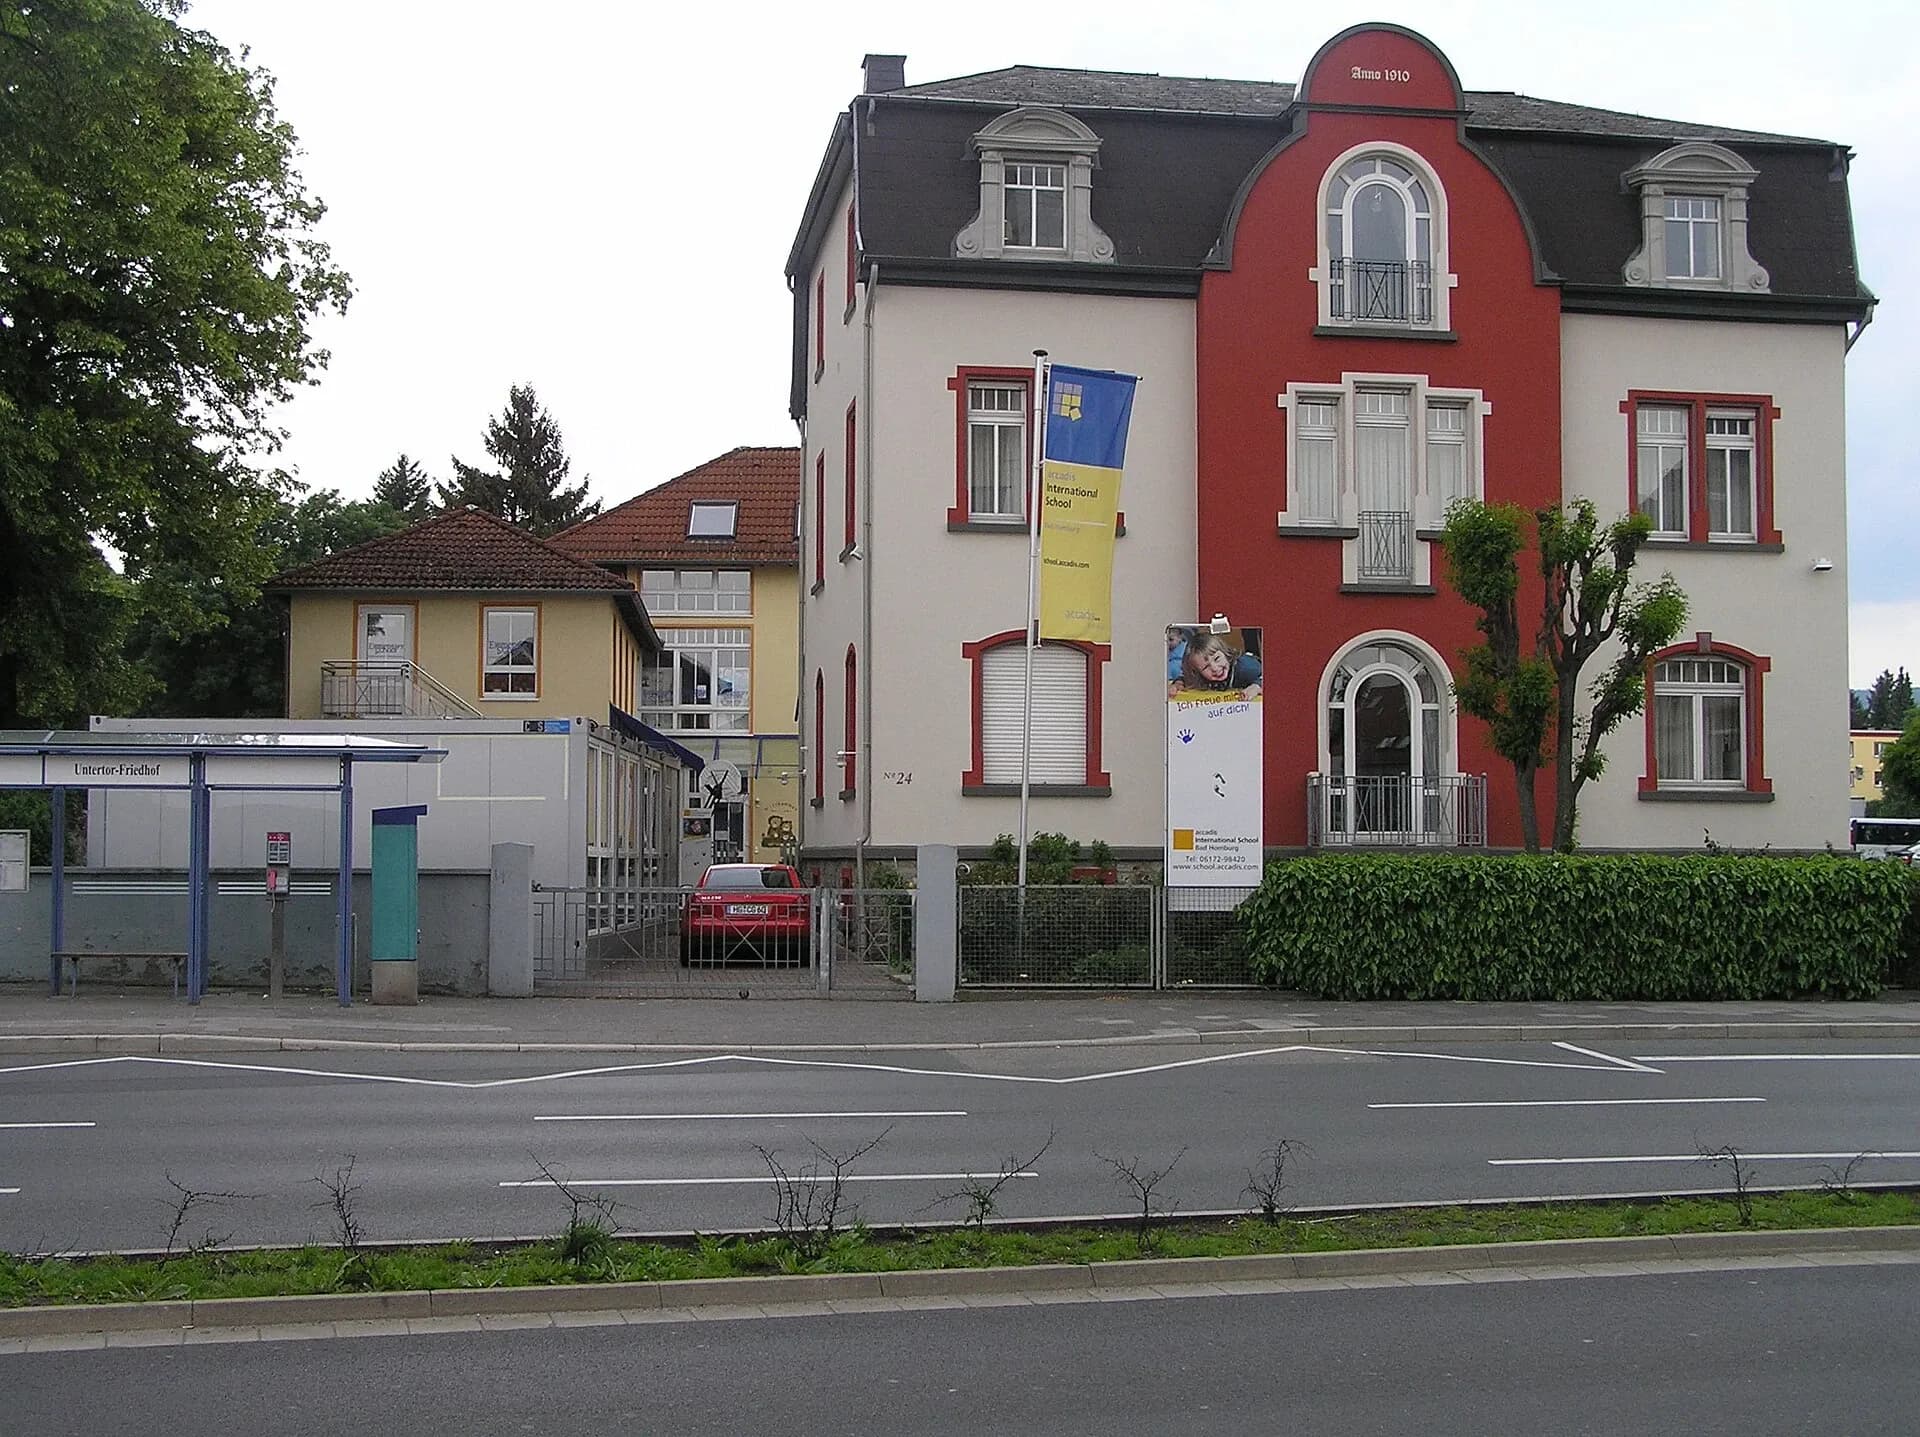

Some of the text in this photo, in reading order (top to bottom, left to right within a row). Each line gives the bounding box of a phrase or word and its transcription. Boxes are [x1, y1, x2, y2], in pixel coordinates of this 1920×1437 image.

[1351, 66, 1410, 82] Anno 1910
[1046, 483, 1098, 498] International
[1045, 496, 1072, 509] School
[1177, 701, 1193, 711] Ich
[1208, 708, 1224, 718] auf
[74, 763, 161, 776] Untertor-Friedhof
[896, 772, 912, 785] 24
[1237, 836, 1259, 844] School
